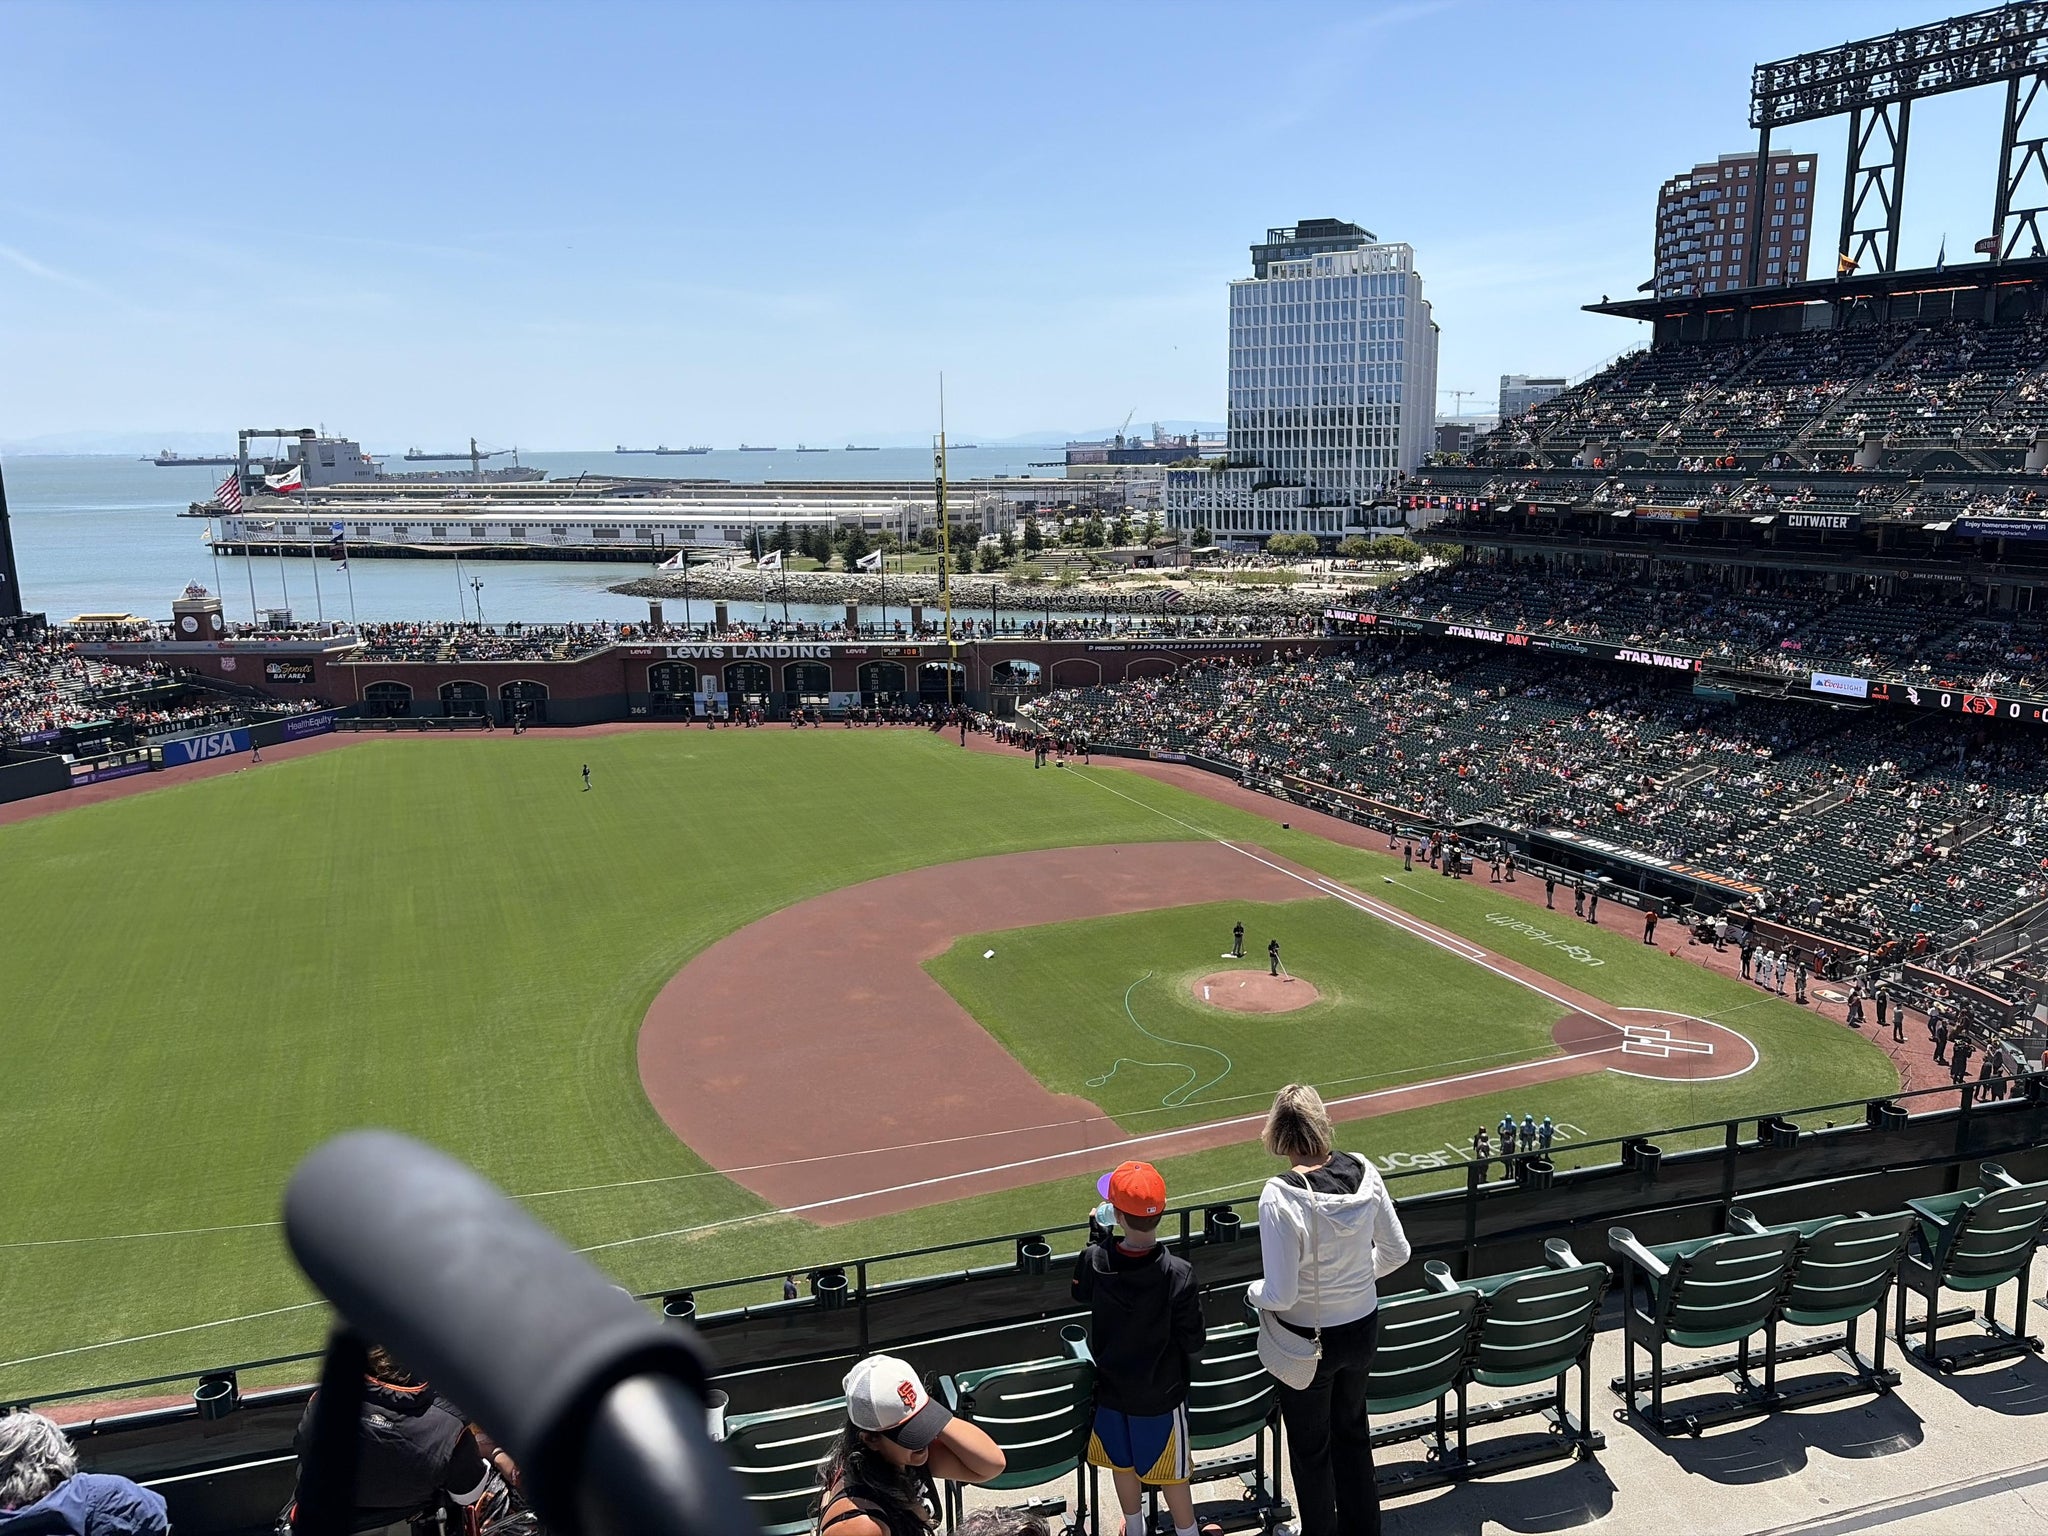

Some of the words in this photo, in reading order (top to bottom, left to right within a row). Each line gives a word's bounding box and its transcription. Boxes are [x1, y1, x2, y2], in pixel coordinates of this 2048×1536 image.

[1788, 515, 1847, 528] CUTWATER
[1965, 521, 1981, 529] Enjoy
[1981, 521, 2031, 531] homerun-worthy
[1025, 596, 1063, 604] BANK
[1067, 596, 1085, 604] OF
[1088, 595, 1153, 605] AMERICA
[1334, 610, 1358, 621] WARS
[1359, 613, 1377, 624] DAY
[1445, 625, 1474, 638] STAR
[1474, 629, 1504, 642] WARS
[1506, 633, 1529, 646] DAY
[732, 646, 831, 659] LANDING
[1555, 641, 1588, 654] EverCharge
[1614, 649, 1652, 665] STAR
[1653, 654, 1692, 670] WARS
[280, 663, 312, 674] Sports
[1823, 678, 1843, 689] Coors
[1844, 684, 1862, 692] LIGHT
[1941, 693, 1951, 708] 0
[2009, 703, 2020, 718] 0
[148, 722, 186, 735] WELCOME
[287, 716, 333, 731] HealthEquity
[180, 732, 236, 761] VISA
[1668, 864, 1692, 872] TO
[1688, 870, 1763, 893] WELCOME
[1485, 912, 1566, 946] Health
[1556, 944, 1605, 967] UCSF
[1372, 1149, 1452, 1172] UCSF
